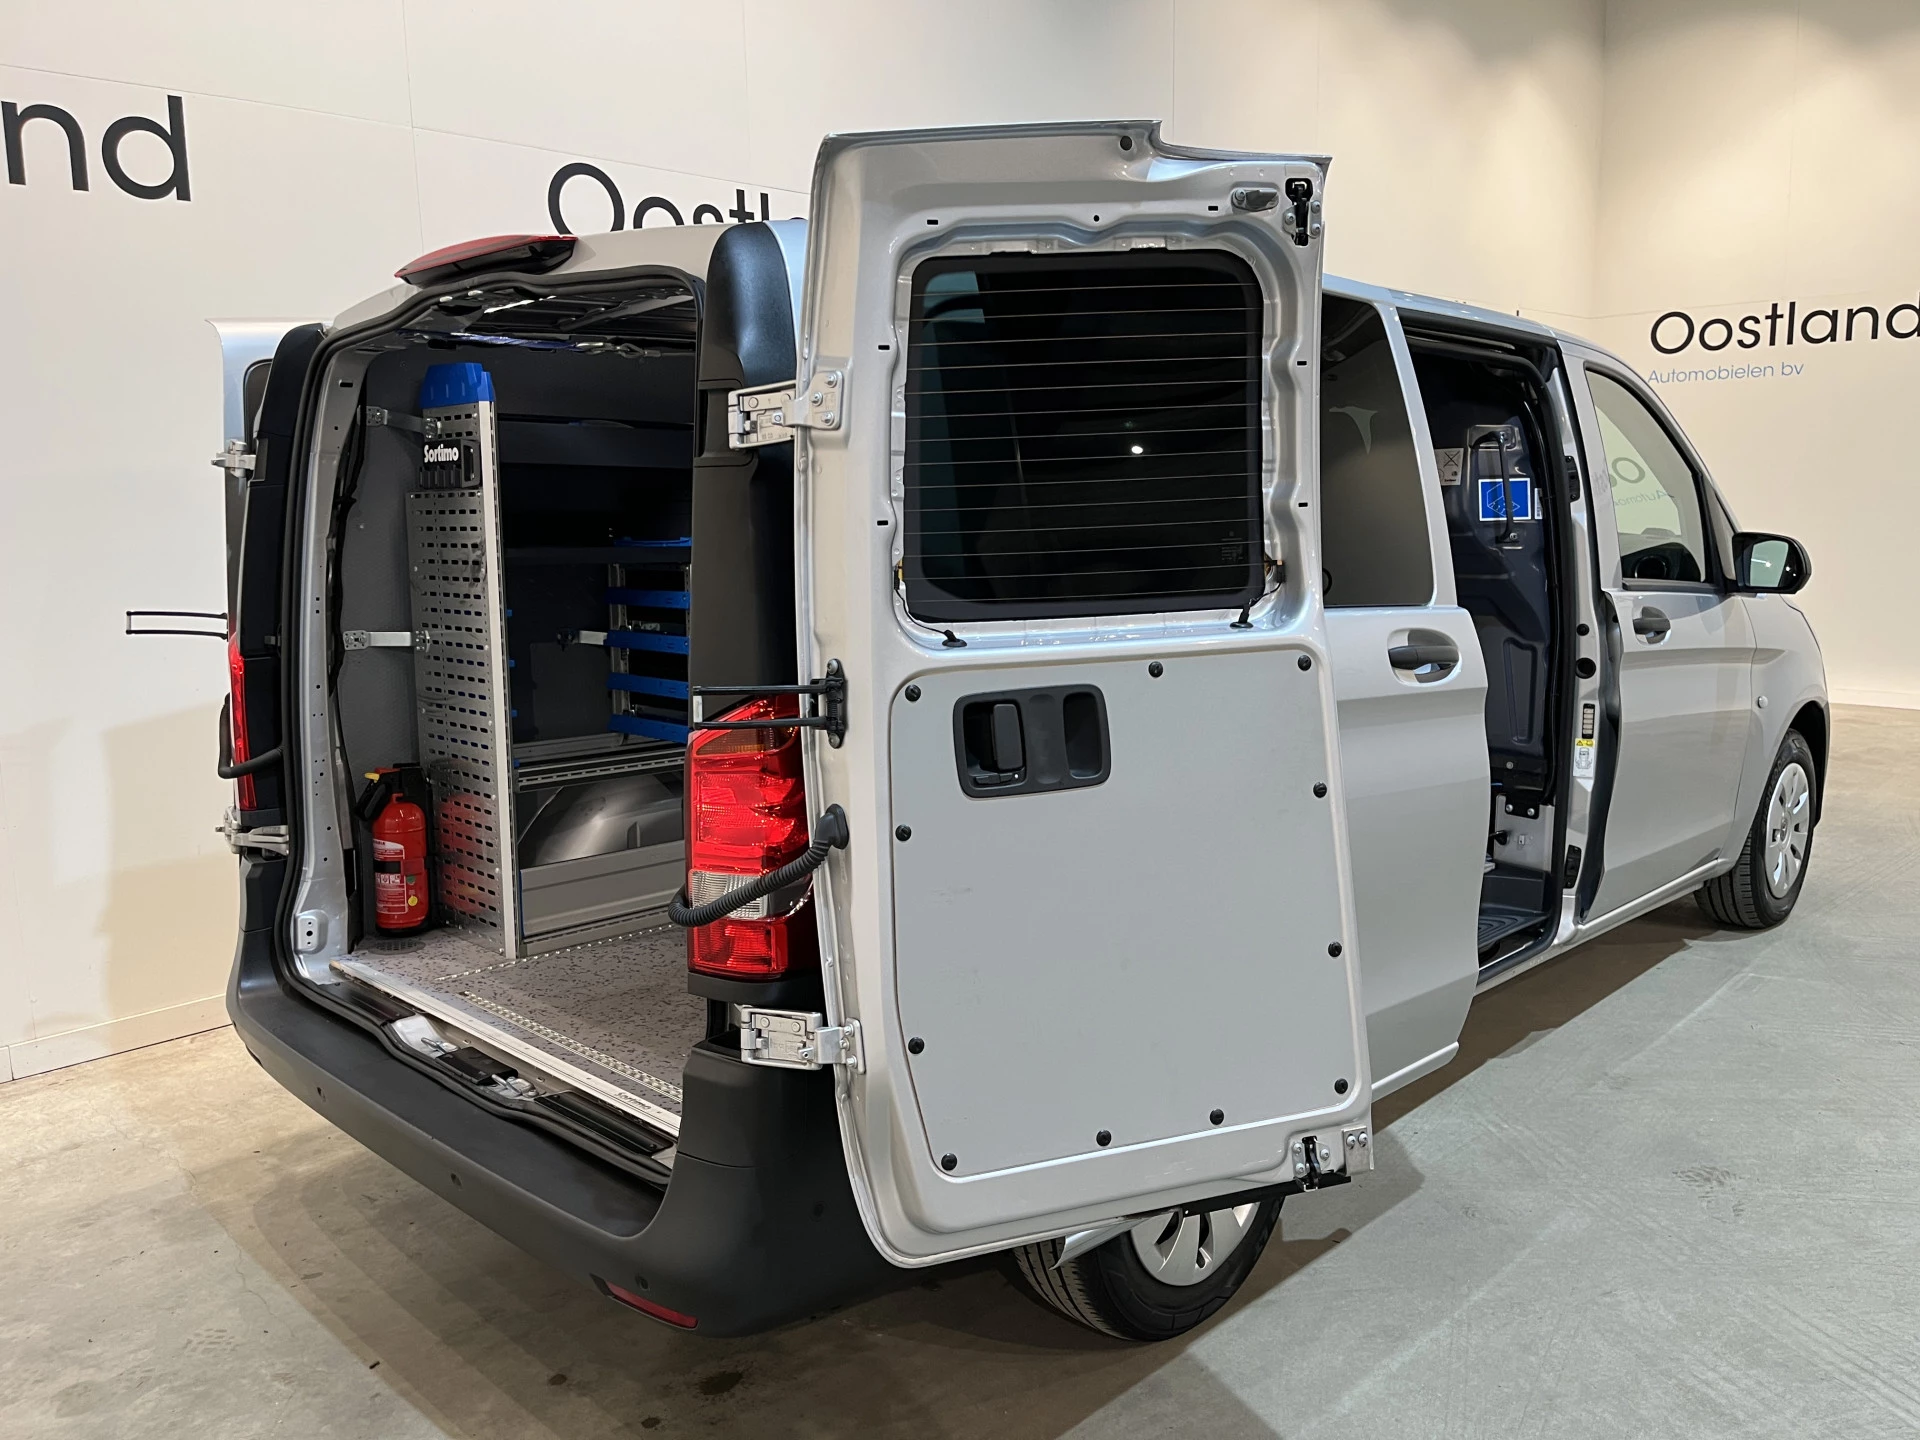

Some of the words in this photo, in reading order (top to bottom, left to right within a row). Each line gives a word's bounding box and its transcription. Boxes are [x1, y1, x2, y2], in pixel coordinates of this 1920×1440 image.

[1, 94, 191, 202] nd
[1650, 292, 1920, 354] Oostland
[1648, 364, 1775, 384] Automobielen
[1781, 361, 1804, 376] bv
[424, 443, 459, 463] Sortimo
